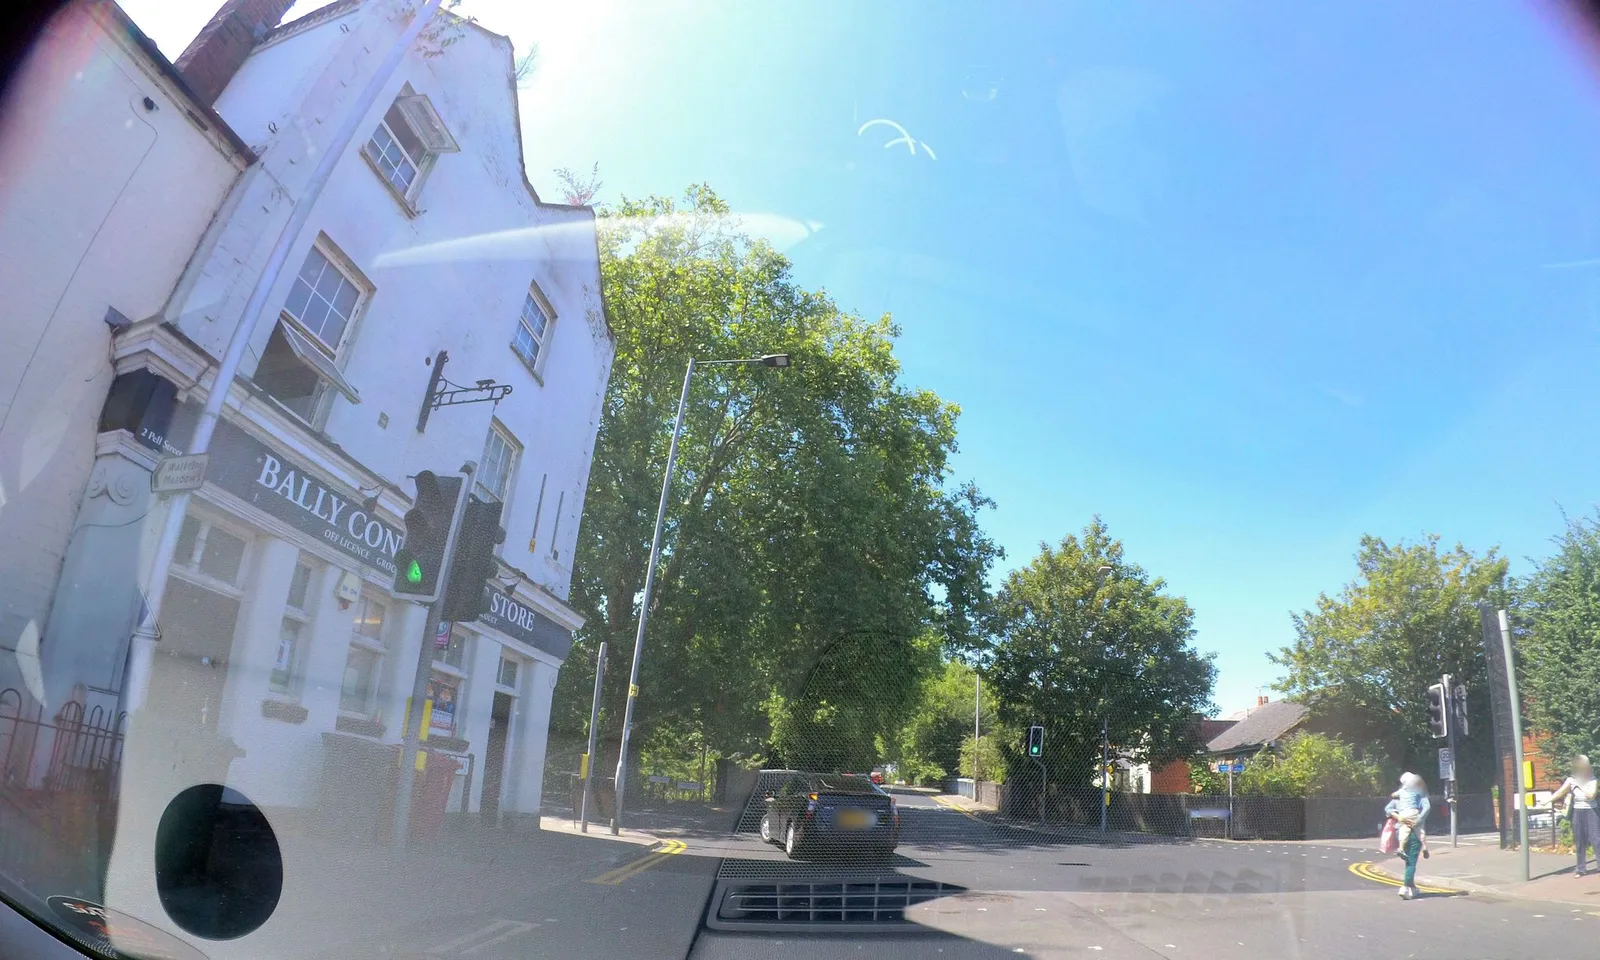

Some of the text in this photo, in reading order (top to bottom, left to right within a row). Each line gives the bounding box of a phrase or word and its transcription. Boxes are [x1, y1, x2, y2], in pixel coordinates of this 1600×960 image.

[141, 428, 148, 437] 2
[148, 431, 163, 446] Pell
[256, 454, 404, 558] BALLY CON
[324, 529, 398, 573] OFF LICENCE GROC
[490, 593, 535, 632] STORE
